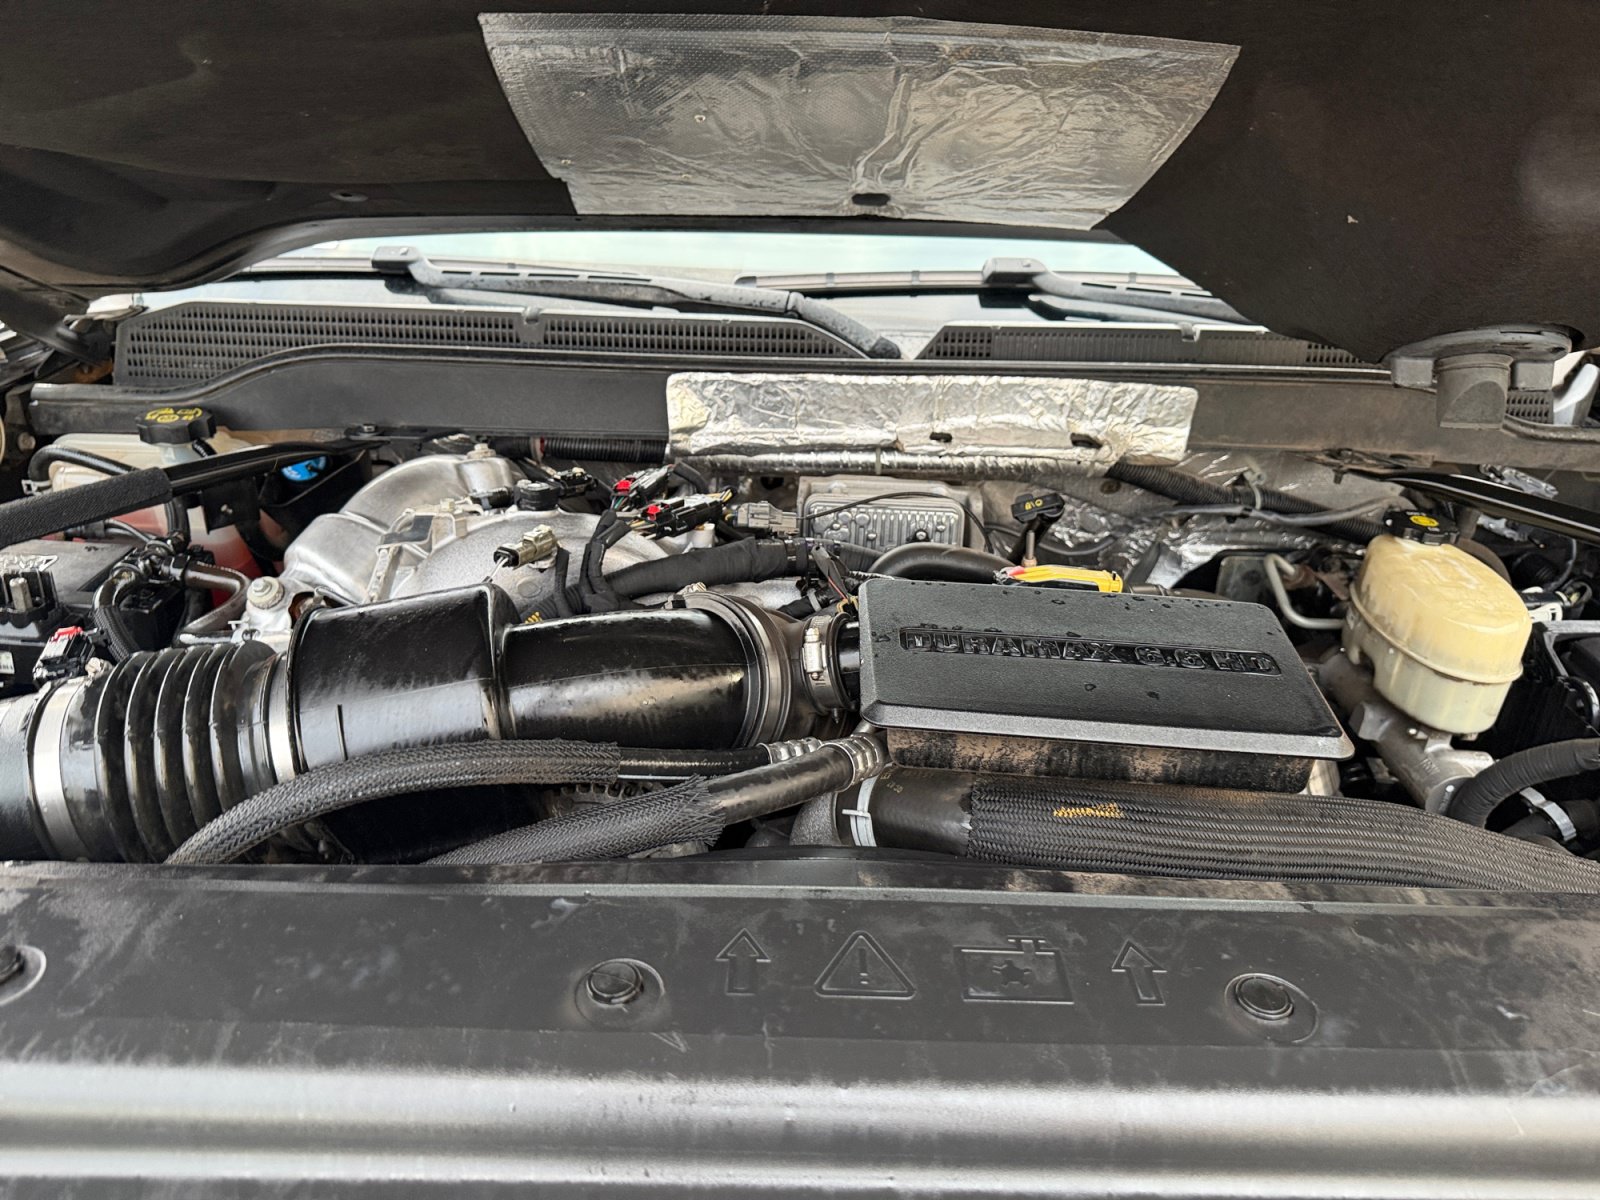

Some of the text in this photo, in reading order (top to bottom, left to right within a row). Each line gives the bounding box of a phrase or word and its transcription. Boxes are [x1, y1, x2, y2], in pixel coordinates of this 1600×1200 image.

[904, 629, 1276, 674] DURAMAX 6.6 HD
